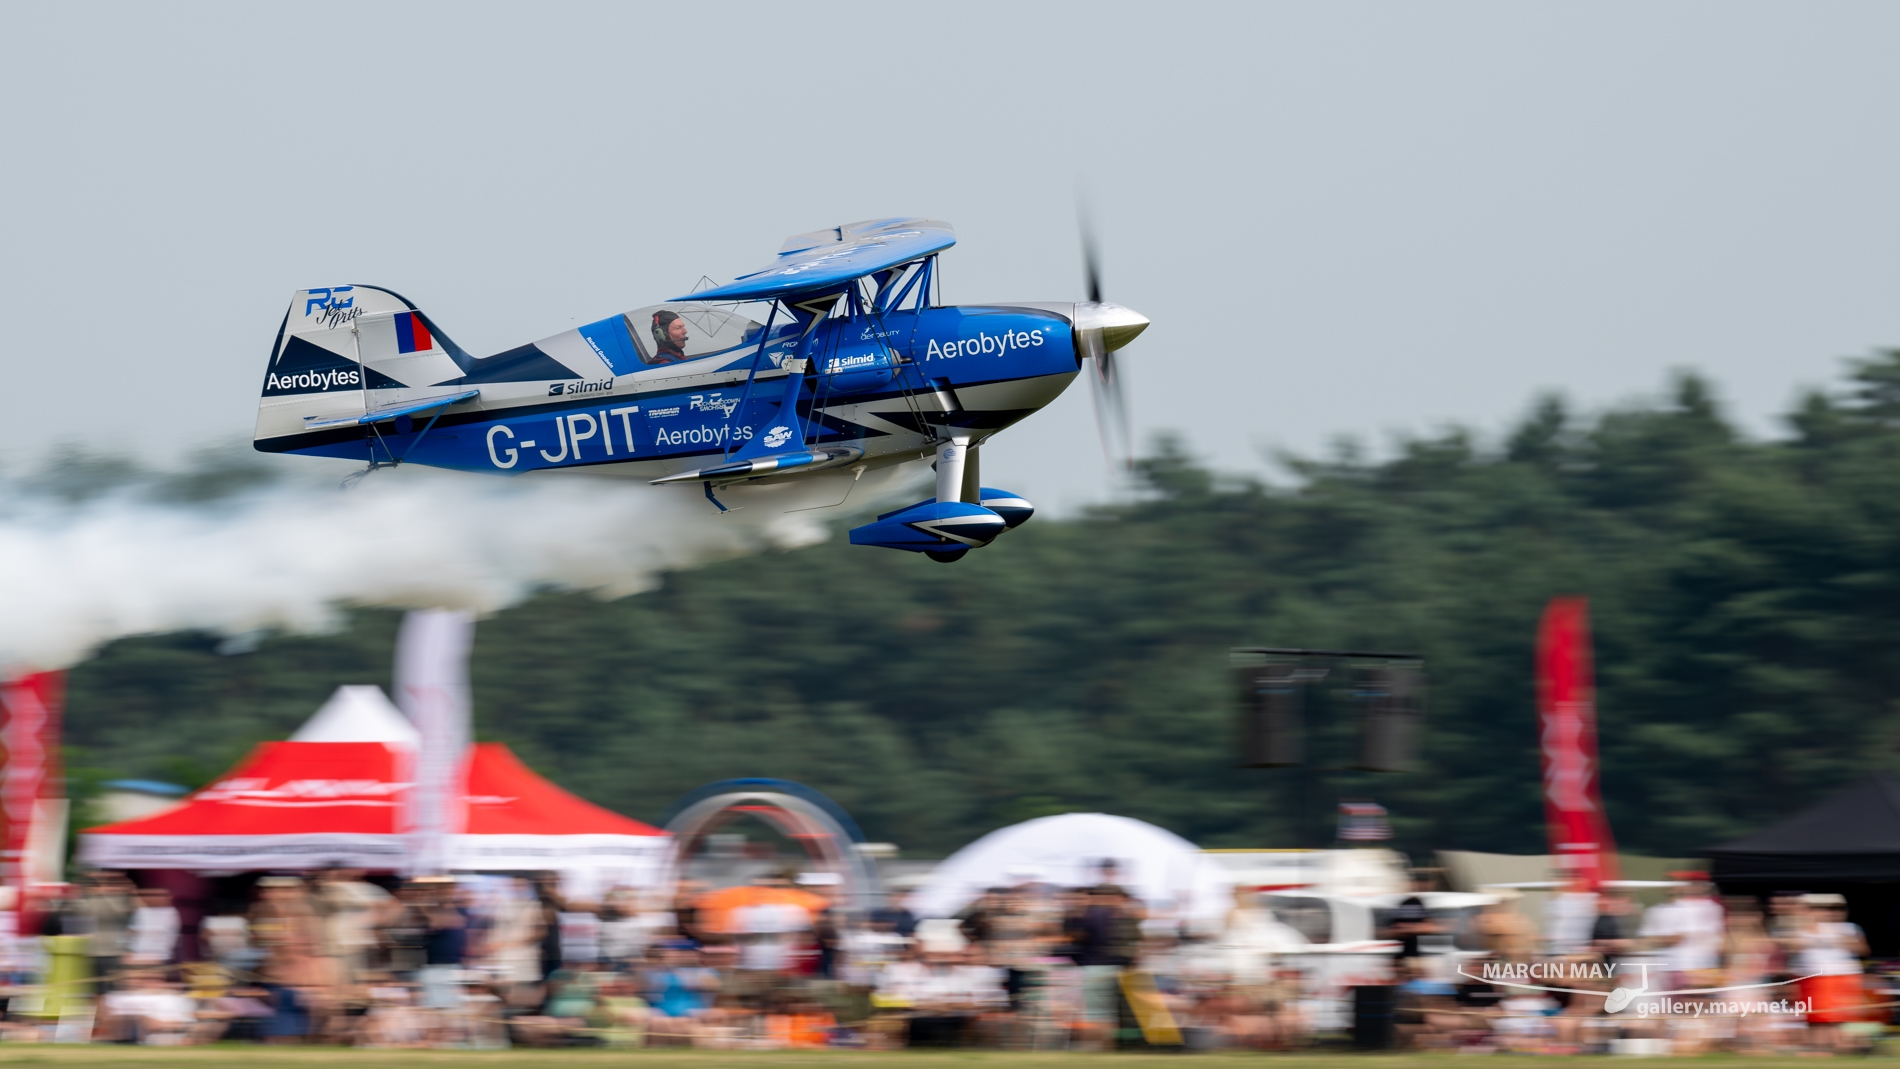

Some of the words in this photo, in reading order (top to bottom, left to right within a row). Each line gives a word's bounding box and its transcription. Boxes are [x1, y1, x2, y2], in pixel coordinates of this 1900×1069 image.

[306, 286, 354, 317] RG
[316, 299, 343, 325] Jet
[586, 336, 601, 352] Richard
[597, 350, 614, 369] Goodwin
[926, 328, 1044, 362] Aerobytes
[841, 352, 874, 366] silmid
[266, 368, 360, 391] Aerobytes
[567, 377, 614, 395] silmid
[486, 405, 639, 469] G-JPIT
[655, 423, 754, 447] Aerobytes
[763, 430, 793, 443] SAW
